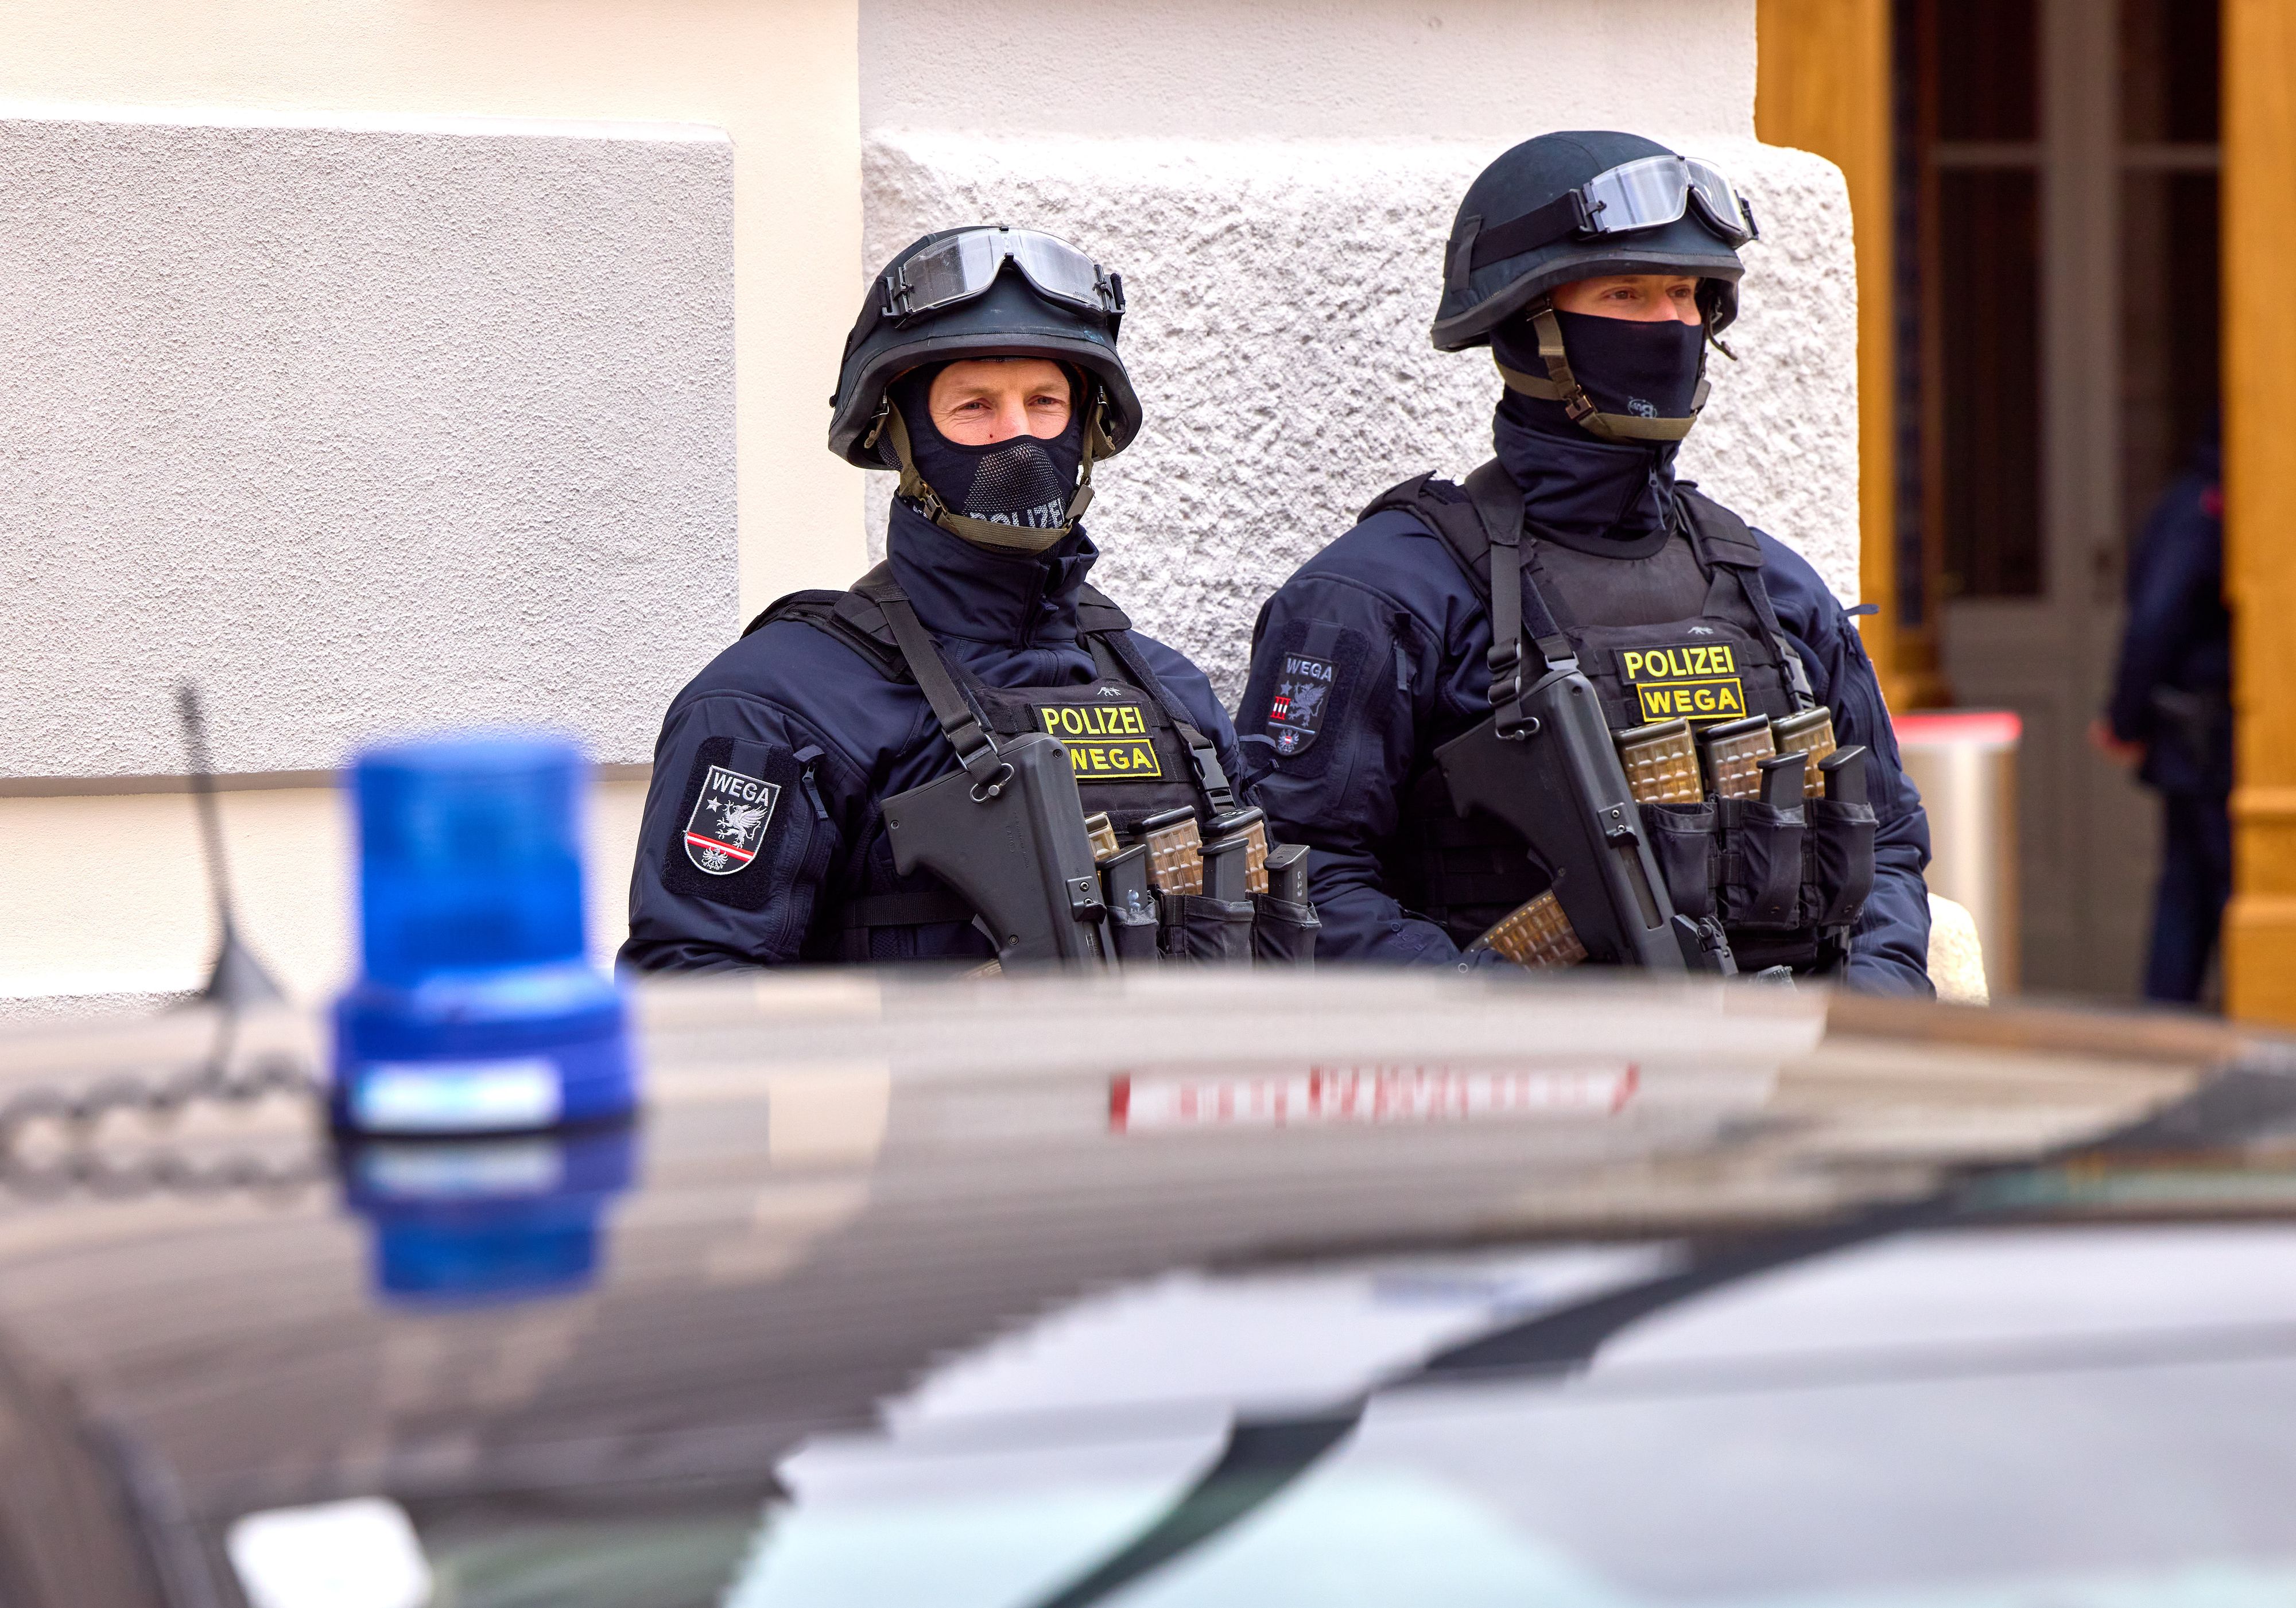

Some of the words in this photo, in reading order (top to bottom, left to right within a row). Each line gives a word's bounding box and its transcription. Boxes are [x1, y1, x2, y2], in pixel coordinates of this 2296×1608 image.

[970, 497, 1065, 529] IZEI
[1286, 658, 1332, 682] WEGA
[1623, 646, 1735, 679] POLIZEI
[1645, 688, 1739, 713] WEGA
[1041, 707, 1146, 735] POLIZEI
[712, 772, 769, 806] WEGA
